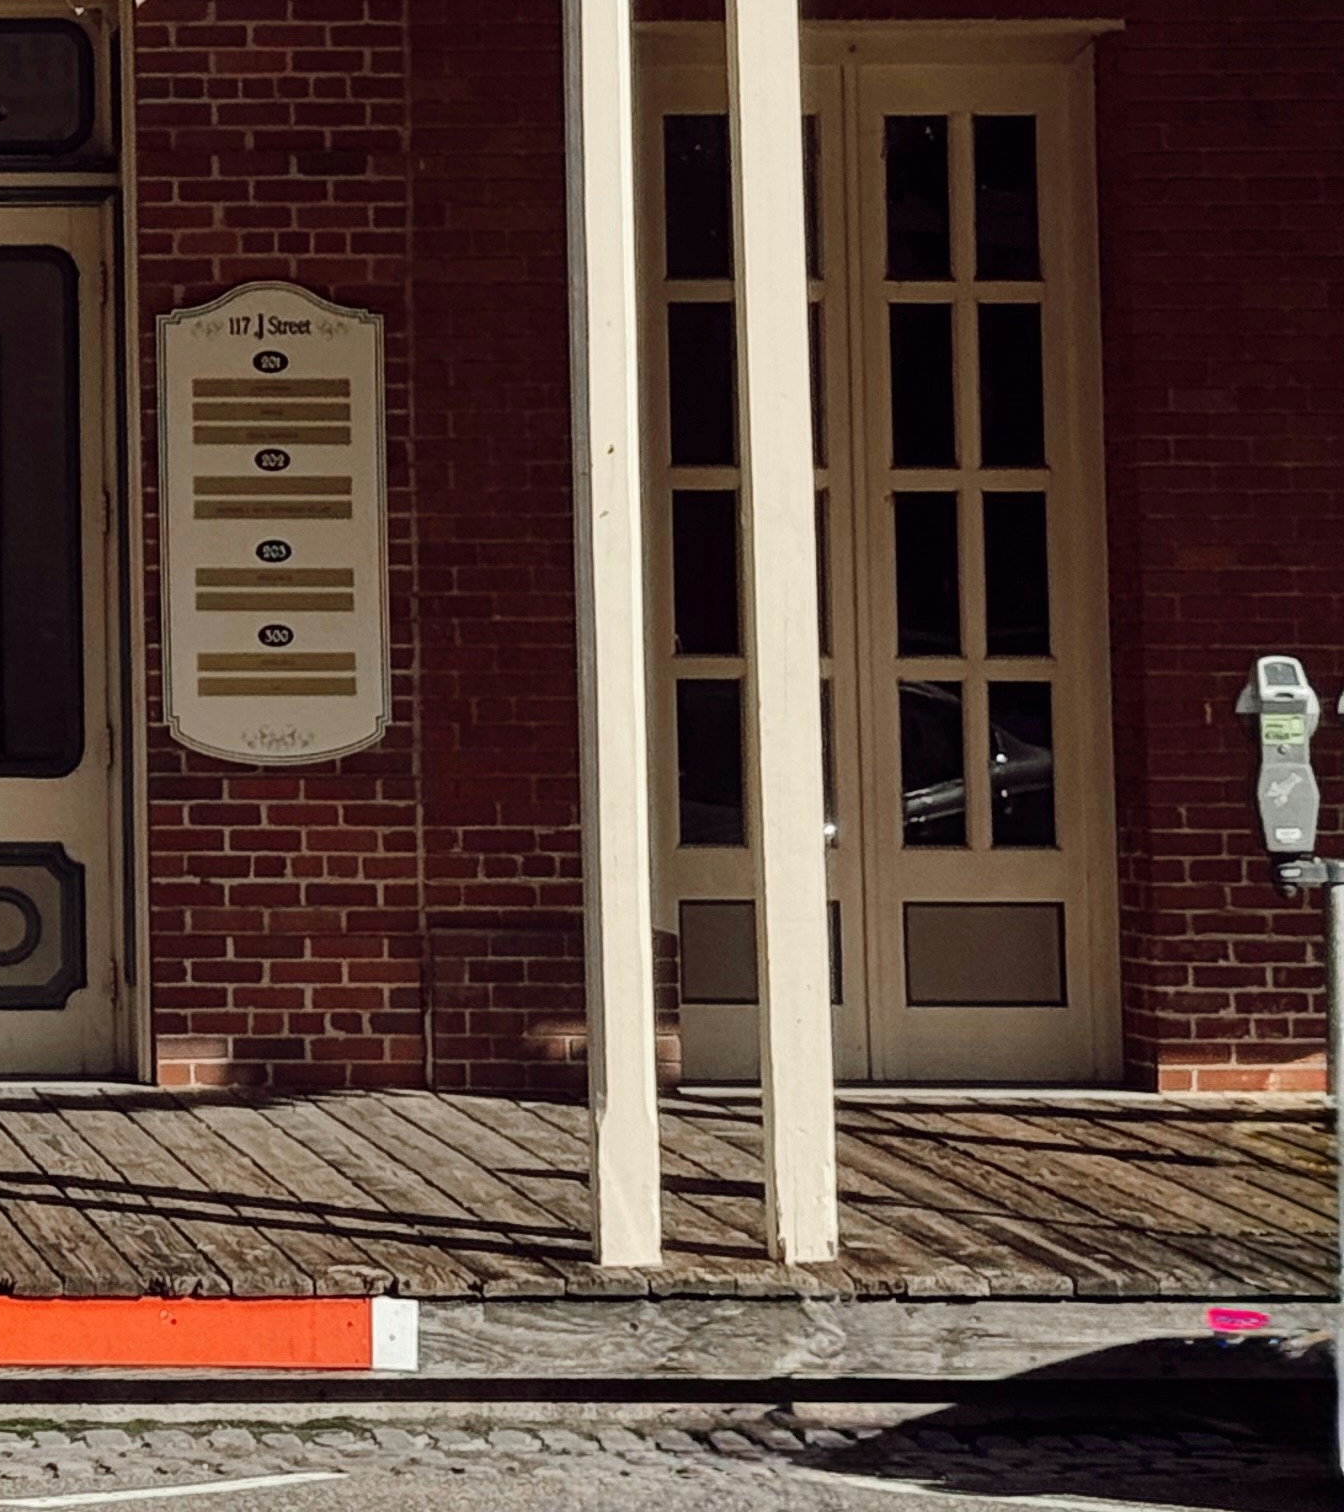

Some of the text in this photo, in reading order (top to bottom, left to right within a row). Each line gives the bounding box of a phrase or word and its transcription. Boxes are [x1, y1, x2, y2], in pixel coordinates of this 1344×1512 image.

[228, 313, 312, 340] 117 J Street
[260, 355, 282, 369] 201
[261, 453, 285, 468] 202
